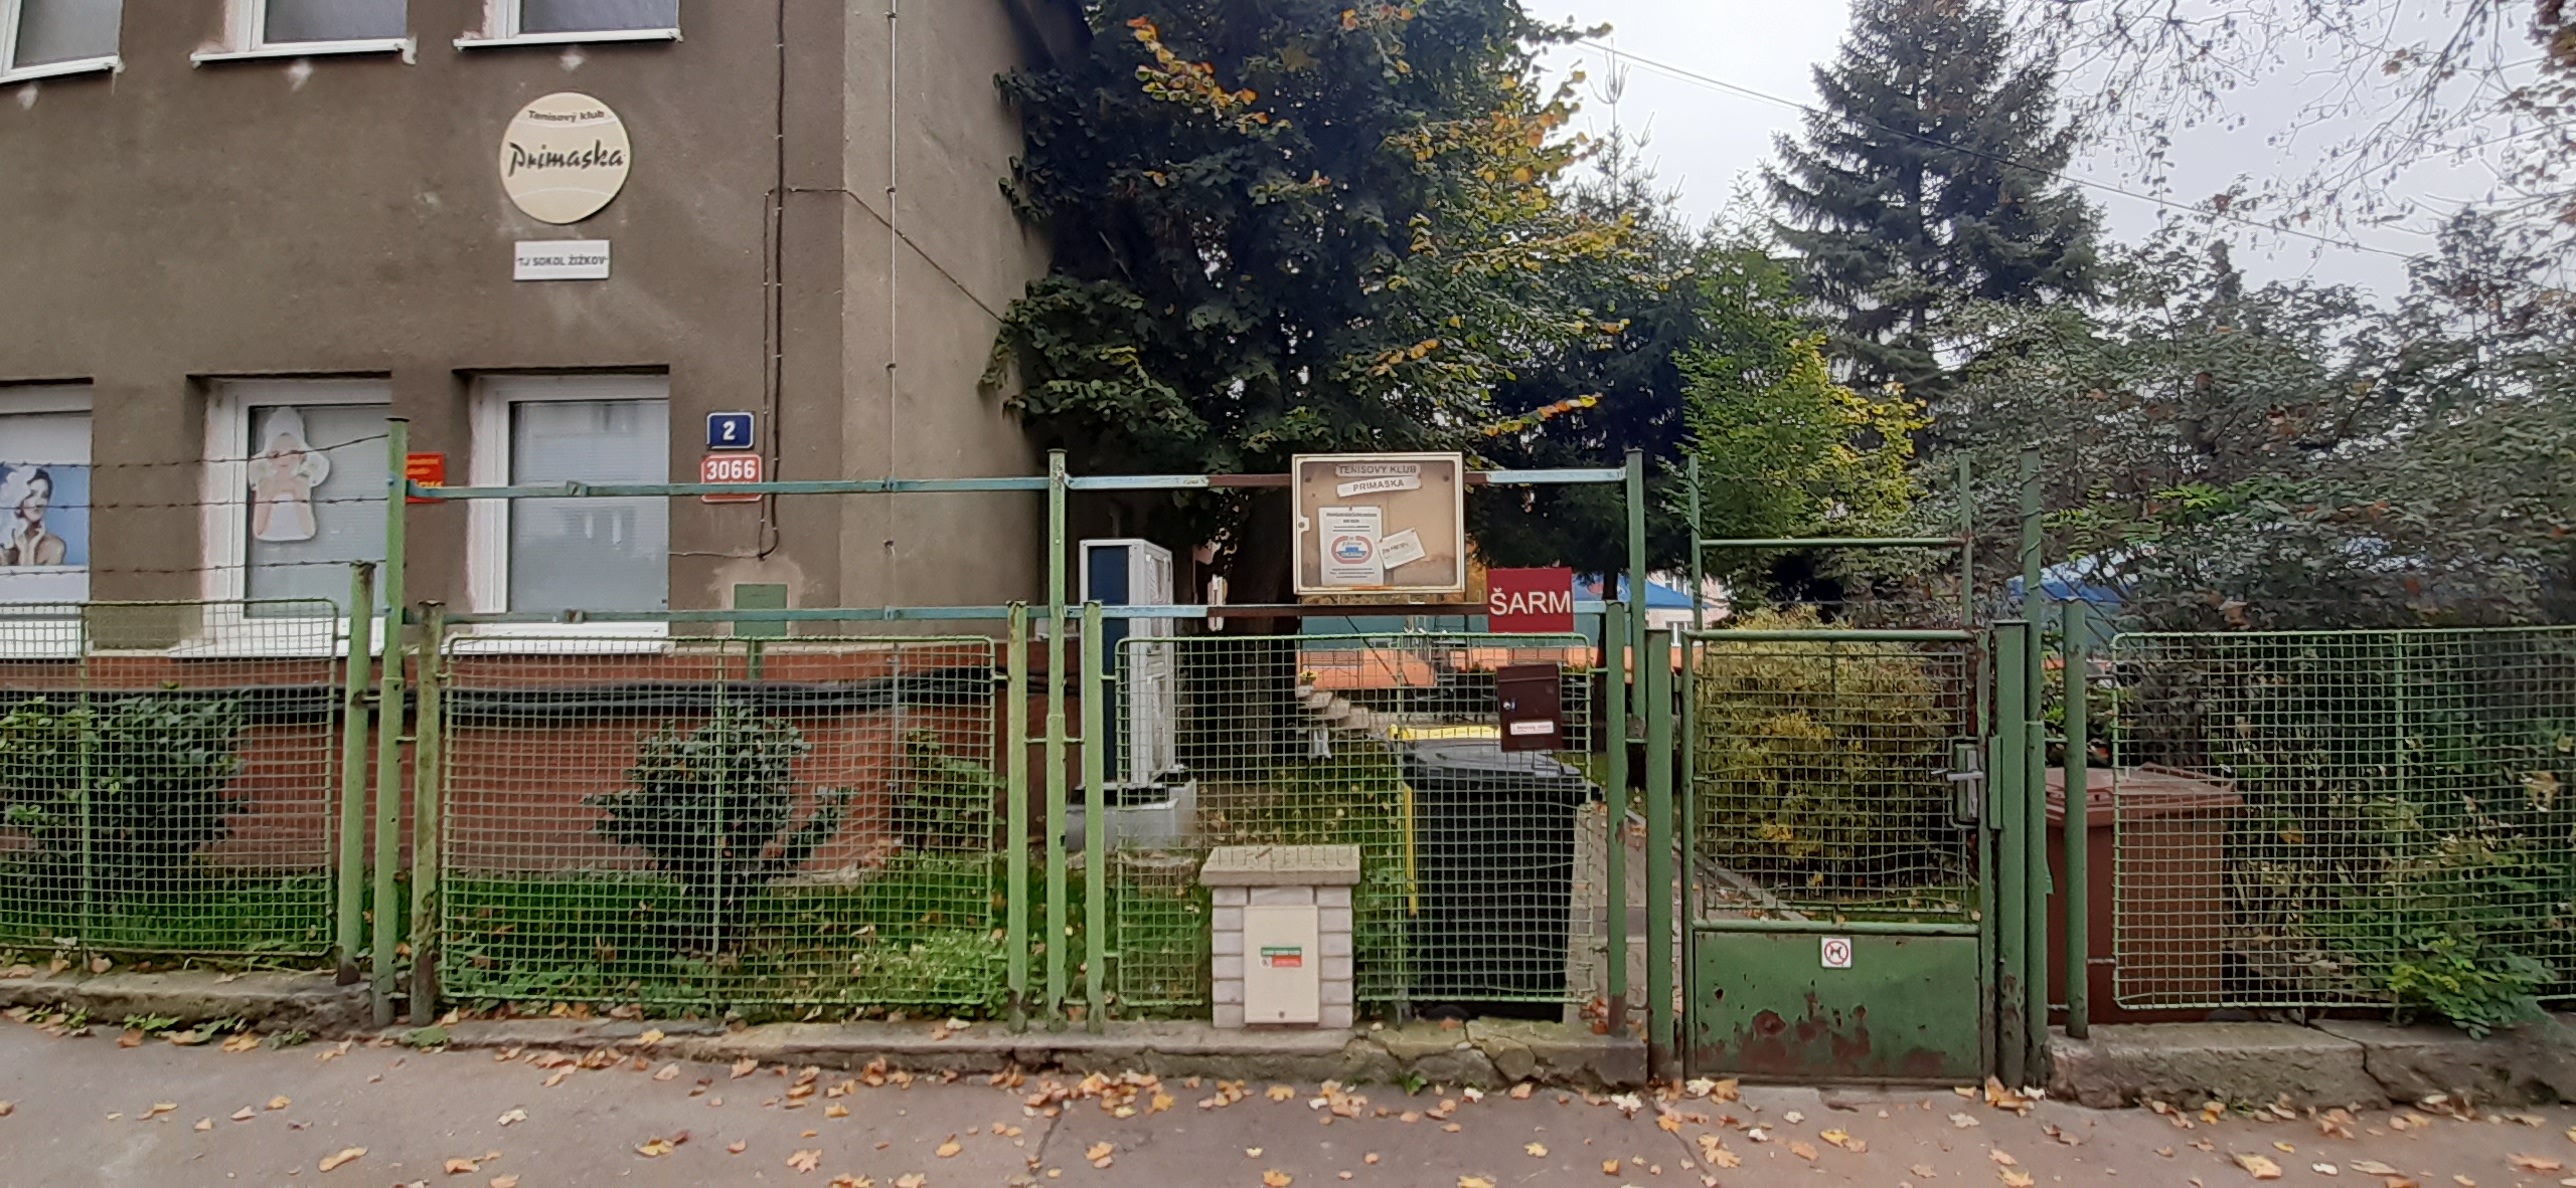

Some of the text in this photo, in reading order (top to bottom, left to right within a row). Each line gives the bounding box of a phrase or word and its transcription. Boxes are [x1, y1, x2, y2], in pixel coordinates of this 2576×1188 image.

[528, 110, 605, 123] Tenisový klub
[508, 139, 624, 177] Primaska
[518, 254, 605, 266] TJ SOKOL ŽIŽKOV
[723, 420, 736, 441] 2
[706, 460, 756, 480] 3066
[1390, 465, 1416, 473] KLUB
[1353, 479, 1404, 491] PRIMASKA
[1489, 587, 1572, 616] ŠARM
